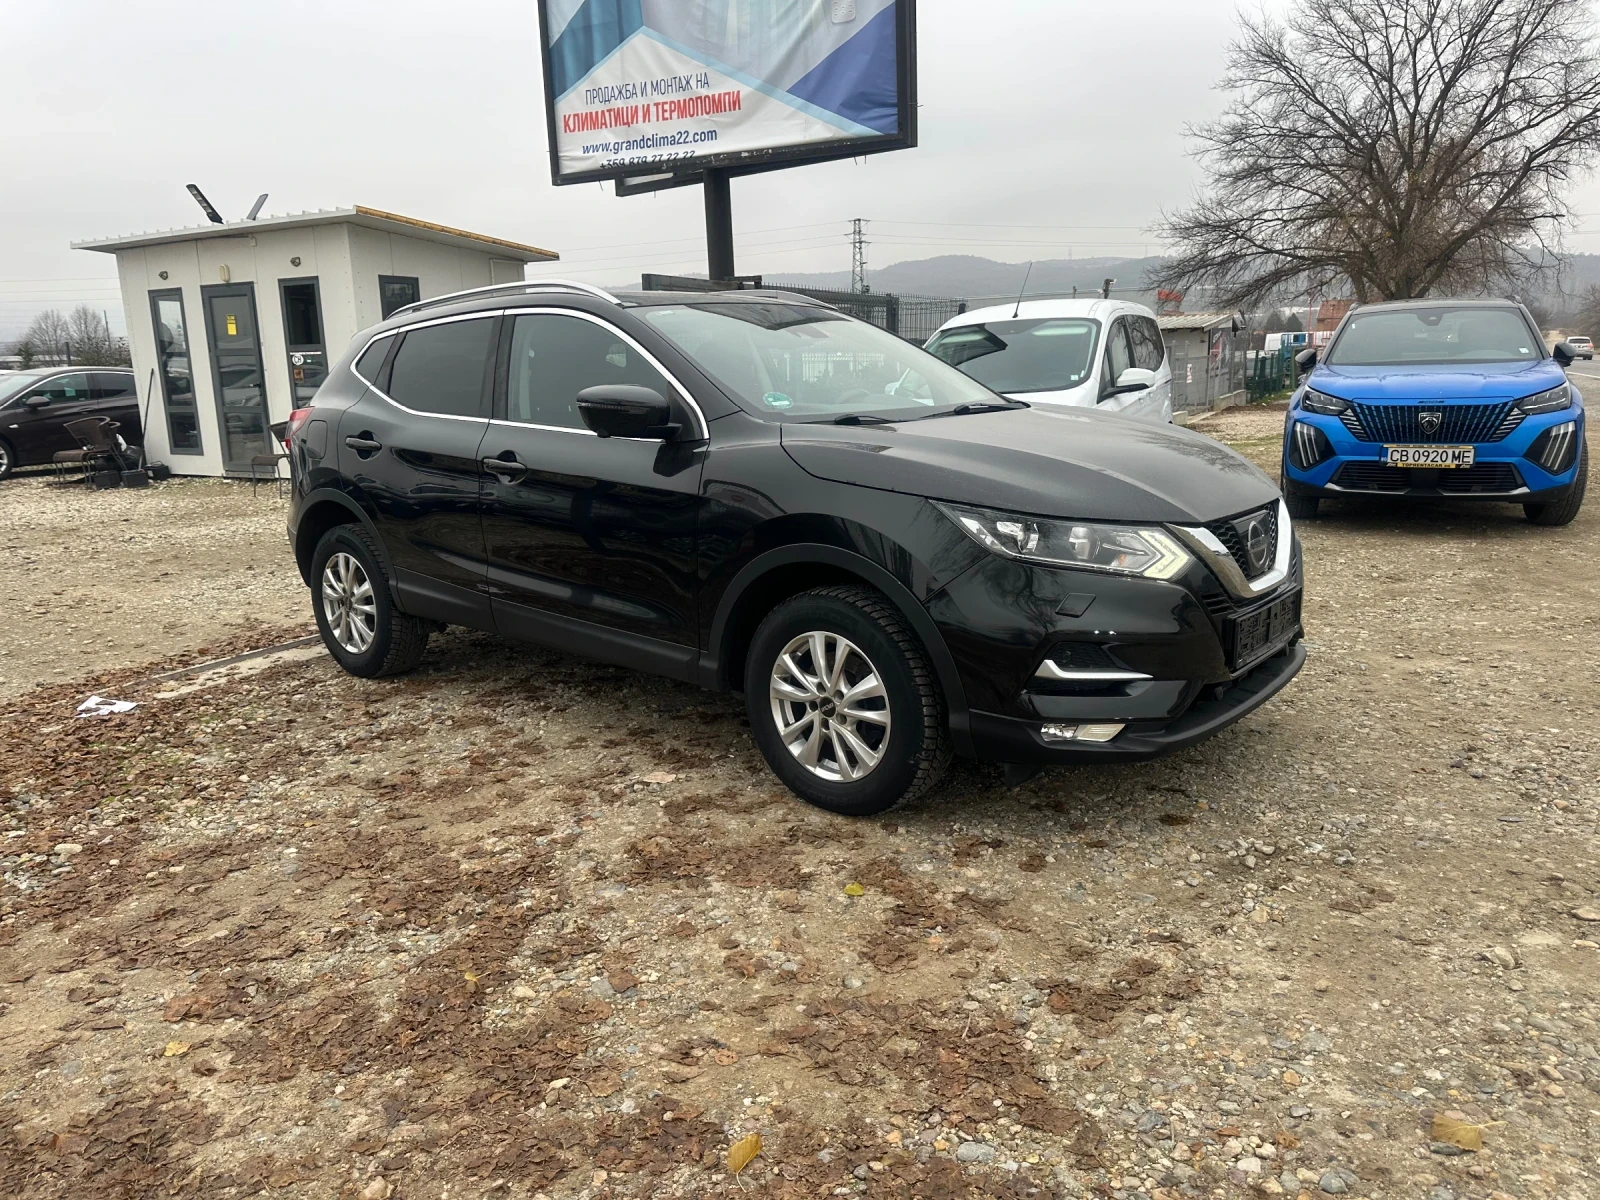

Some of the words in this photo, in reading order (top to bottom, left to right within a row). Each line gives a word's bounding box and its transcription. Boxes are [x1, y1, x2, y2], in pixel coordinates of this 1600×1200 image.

[585, 83, 638, 105] ПРОДАЖБА
[641, 81, 648, 97] И
[651, 74, 693, 95] МОНТАЖ
[695, 72, 709, 90] НА
[563, 105, 639, 133] КЛИМАТИЦИ
[642, 103, 651, 123] И
[654, 90, 741, 122] ТЕРМОПОМПИ
[582, 129, 717, 154] www.grandclima22.com
[1390, 449, 1408, 462] CB
[1412, 449, 1449, 463] 0920
[1451, 450, 1471, 464] ME
